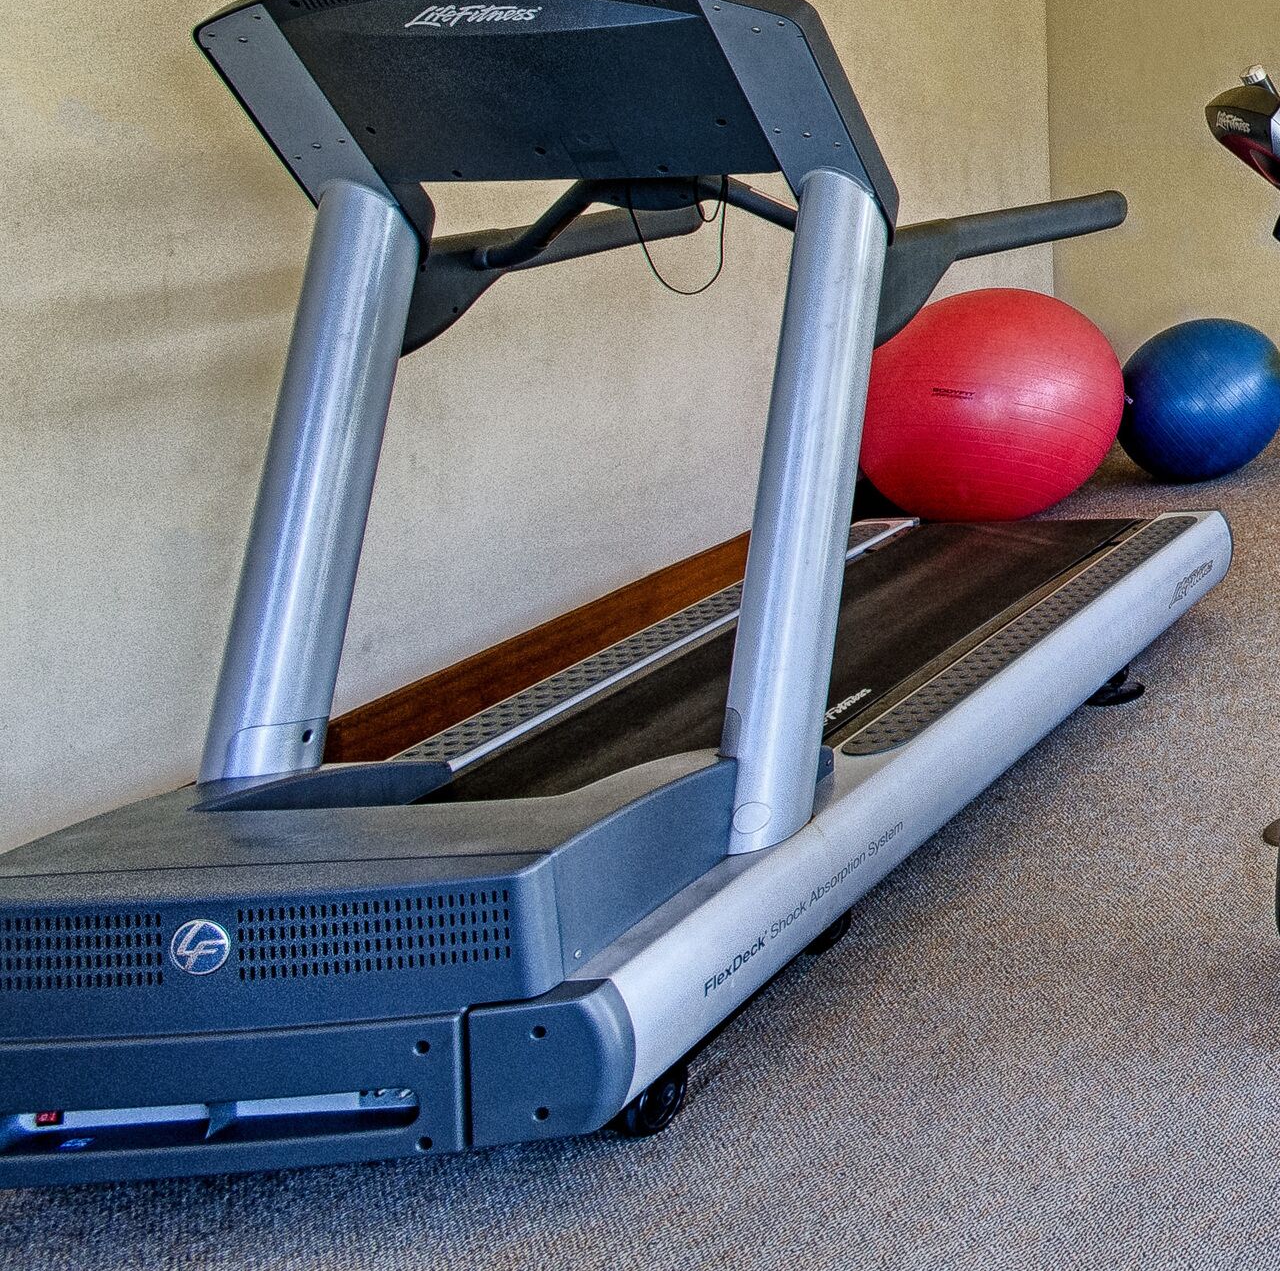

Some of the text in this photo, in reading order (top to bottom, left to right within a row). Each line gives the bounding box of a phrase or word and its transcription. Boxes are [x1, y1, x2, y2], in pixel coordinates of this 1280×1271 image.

[703, 821, 904, 998] FlexDeck Shock Absorption System
